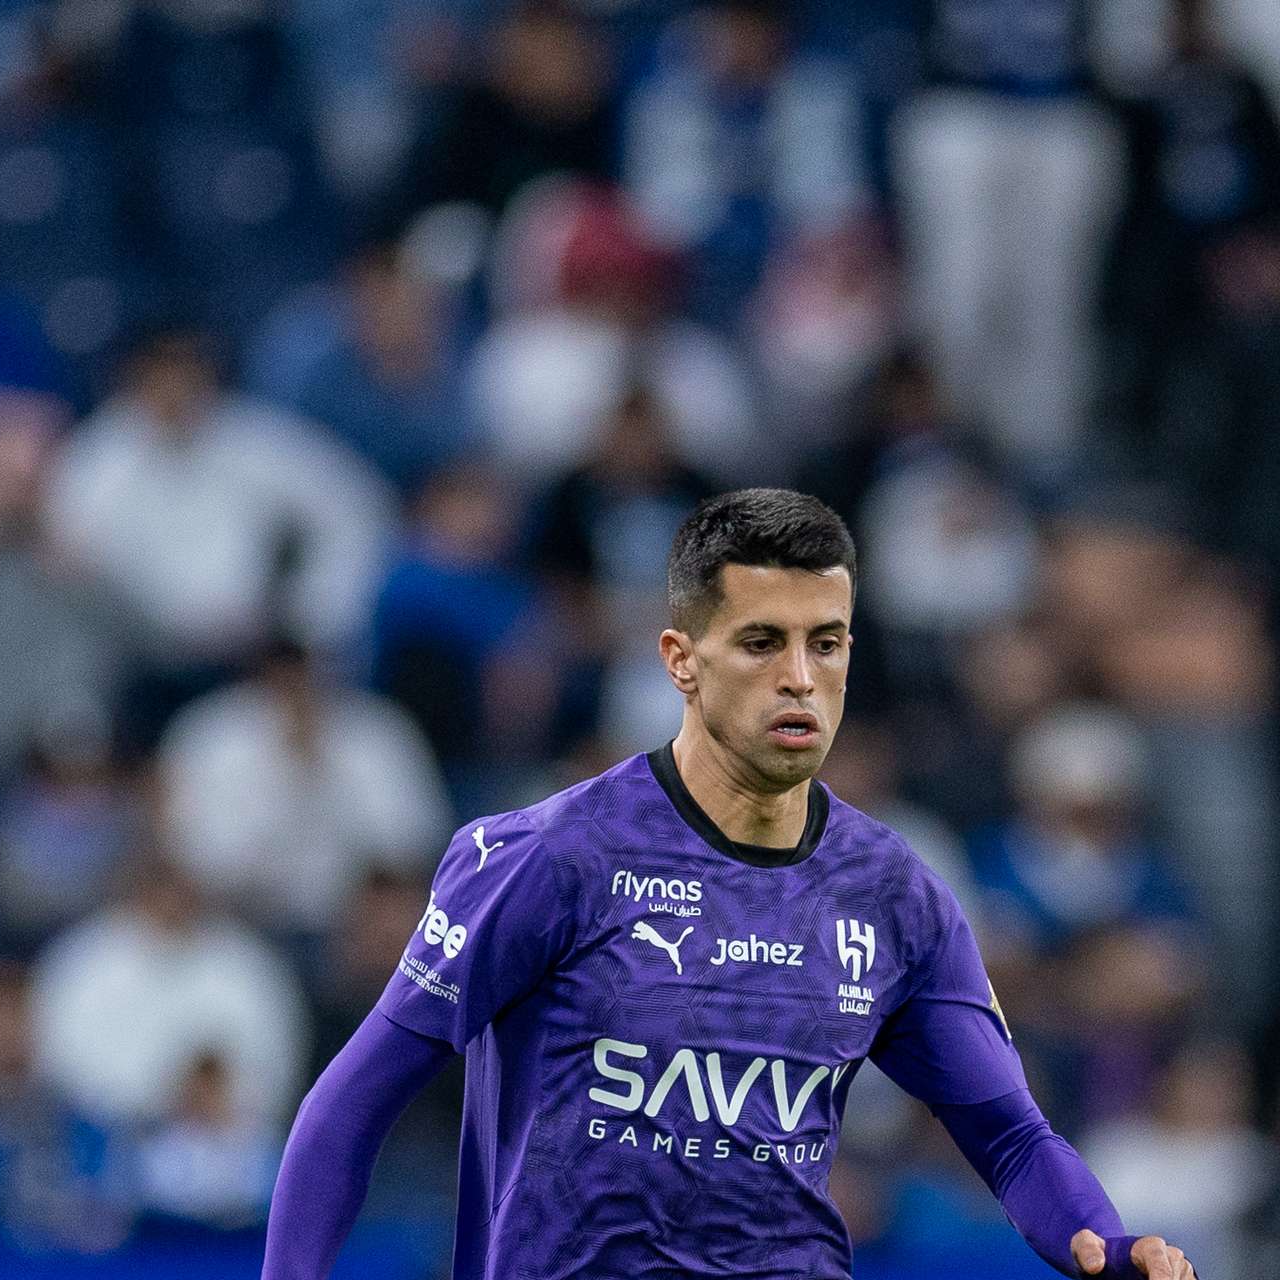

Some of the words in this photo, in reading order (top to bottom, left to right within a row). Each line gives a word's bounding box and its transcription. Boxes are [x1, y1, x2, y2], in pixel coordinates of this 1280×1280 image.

[611, 870, 703, 902] flynas
[648, 901, 674, 913] ناس
[588, 1117, 731, 1159] GAMES
[752, 1137, 830, 1165] GROU
